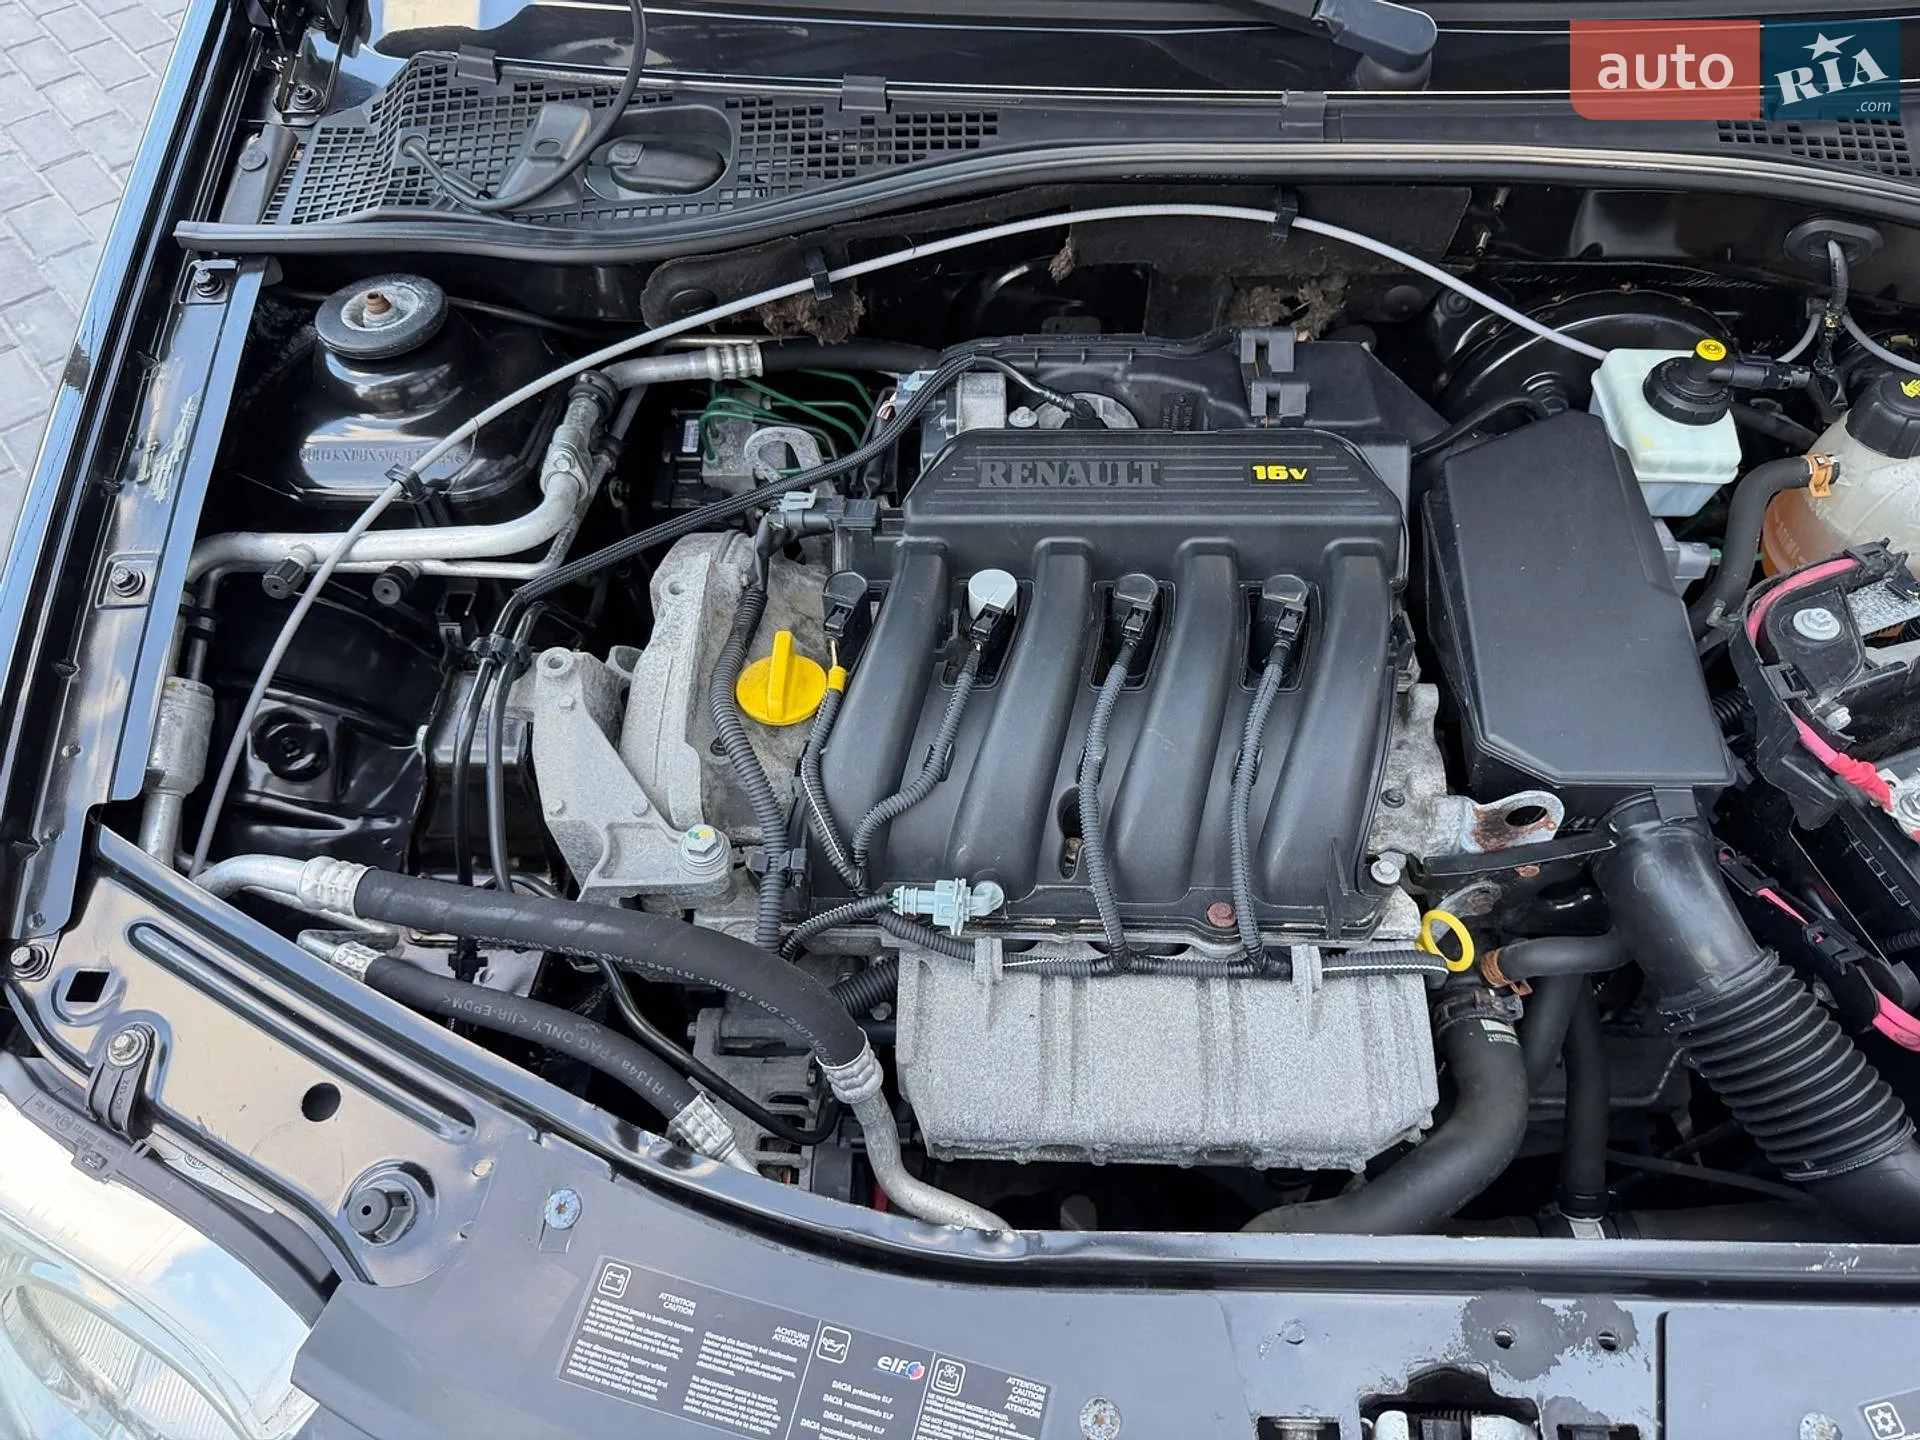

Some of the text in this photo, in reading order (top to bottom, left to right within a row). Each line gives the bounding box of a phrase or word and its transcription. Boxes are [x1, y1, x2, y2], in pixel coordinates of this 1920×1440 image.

[977, 461, 1160, 487] RENAULT
[1252, 464, 1308, 481] 16v
[559, 946, 598, 958] ONLY
[709, 979, 735, 992] mm
[758, 1000, 779, 1013] DN
[532, 1020, 574, 1044] ONLY
[659, 1292, 697, 1309] ATTENTION
[663, 1301, 694, 1316] CAUTION
[774, 1326, 811, 1341] ACHTUNG
[877, 1356, 909, 1374] elf
[831, 1381, 852, 1392] DACIA
[882, 1396, 893, 1404] ELF
[1006, 1376, 1047, 1394] ATTENTION
[1008, 1394, 1043, 1410] ACHTUNG
[1011, 1386, 1045, 1402] CAUTION
[823, 1394, 844, 1405] DACIA
[883, 1412, 894, 1420] ELF
[800, 1418, 821, 1430] DACIA
[823, 1410, 844, 1422] DACIA
[874, 1426, 885, 1434] ELF
